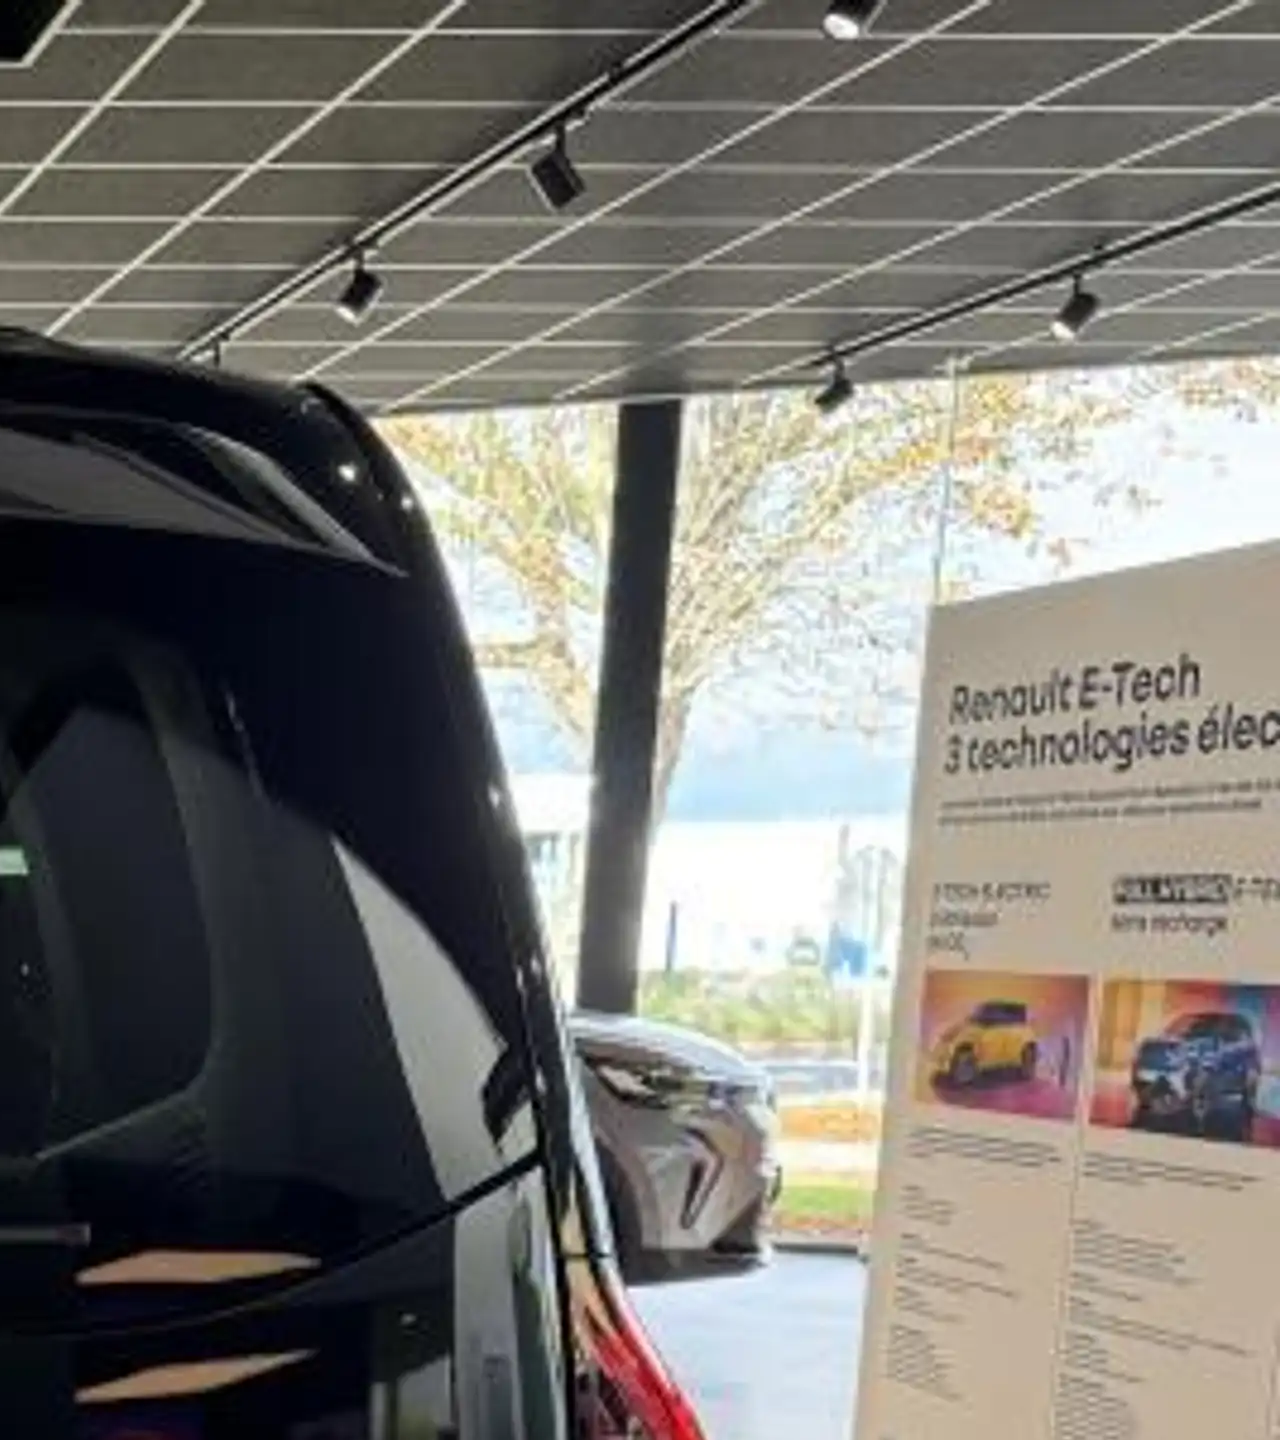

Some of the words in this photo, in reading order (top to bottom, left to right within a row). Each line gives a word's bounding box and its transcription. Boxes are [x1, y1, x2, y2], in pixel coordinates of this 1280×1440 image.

[949, 667, 1074, 725] Renault
[1078, 653, 1201, 709] E-Tech
[944, 734, 962, 774] 3
[967, 710, 1191, 772] technologies
